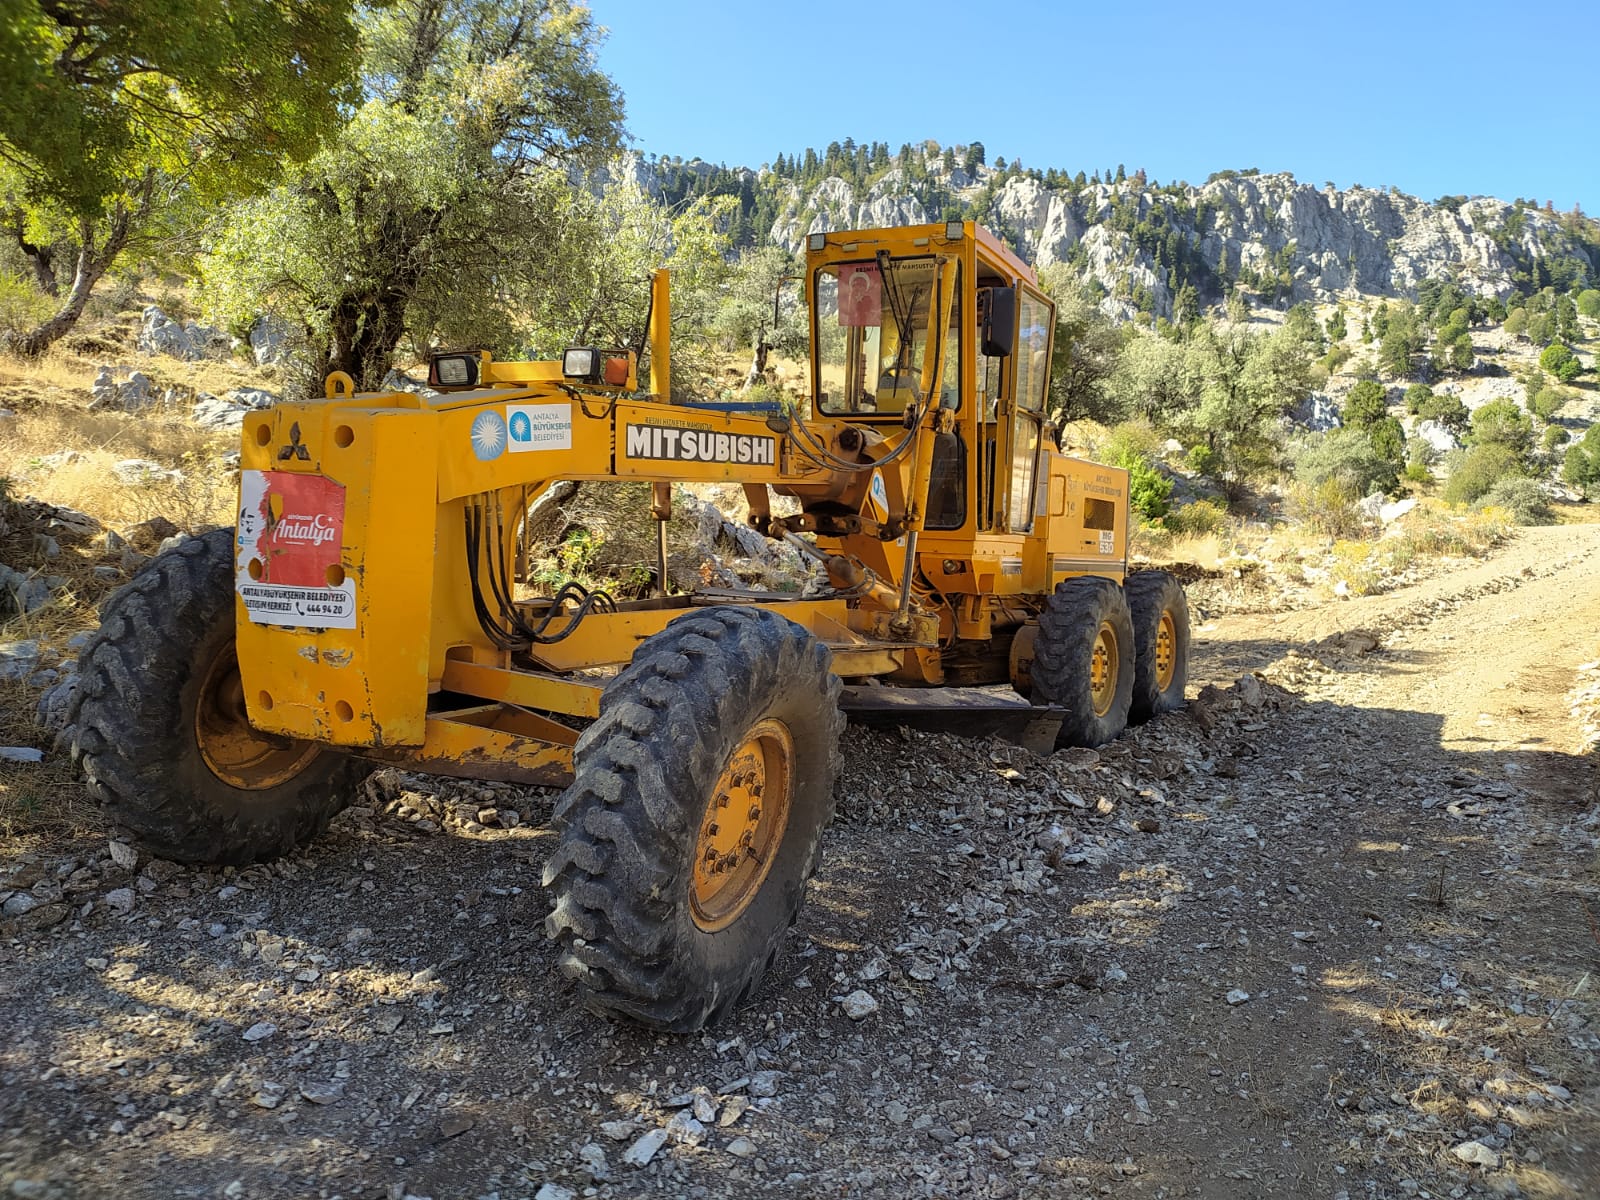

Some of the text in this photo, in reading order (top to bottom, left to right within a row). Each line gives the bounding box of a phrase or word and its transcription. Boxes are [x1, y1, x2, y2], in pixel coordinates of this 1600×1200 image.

[533, 413, 560, 421] ANTALYA
[627, 425, 775, 464] MITSUBISHI
[272, 518, 335, 546] Antalya
[306, 591, 346, 602] BELEDİYESİ
[306, 604, 321, 613] 444
[322, 605, 332, 614] 94
[333, 606, 343, 614] 20
